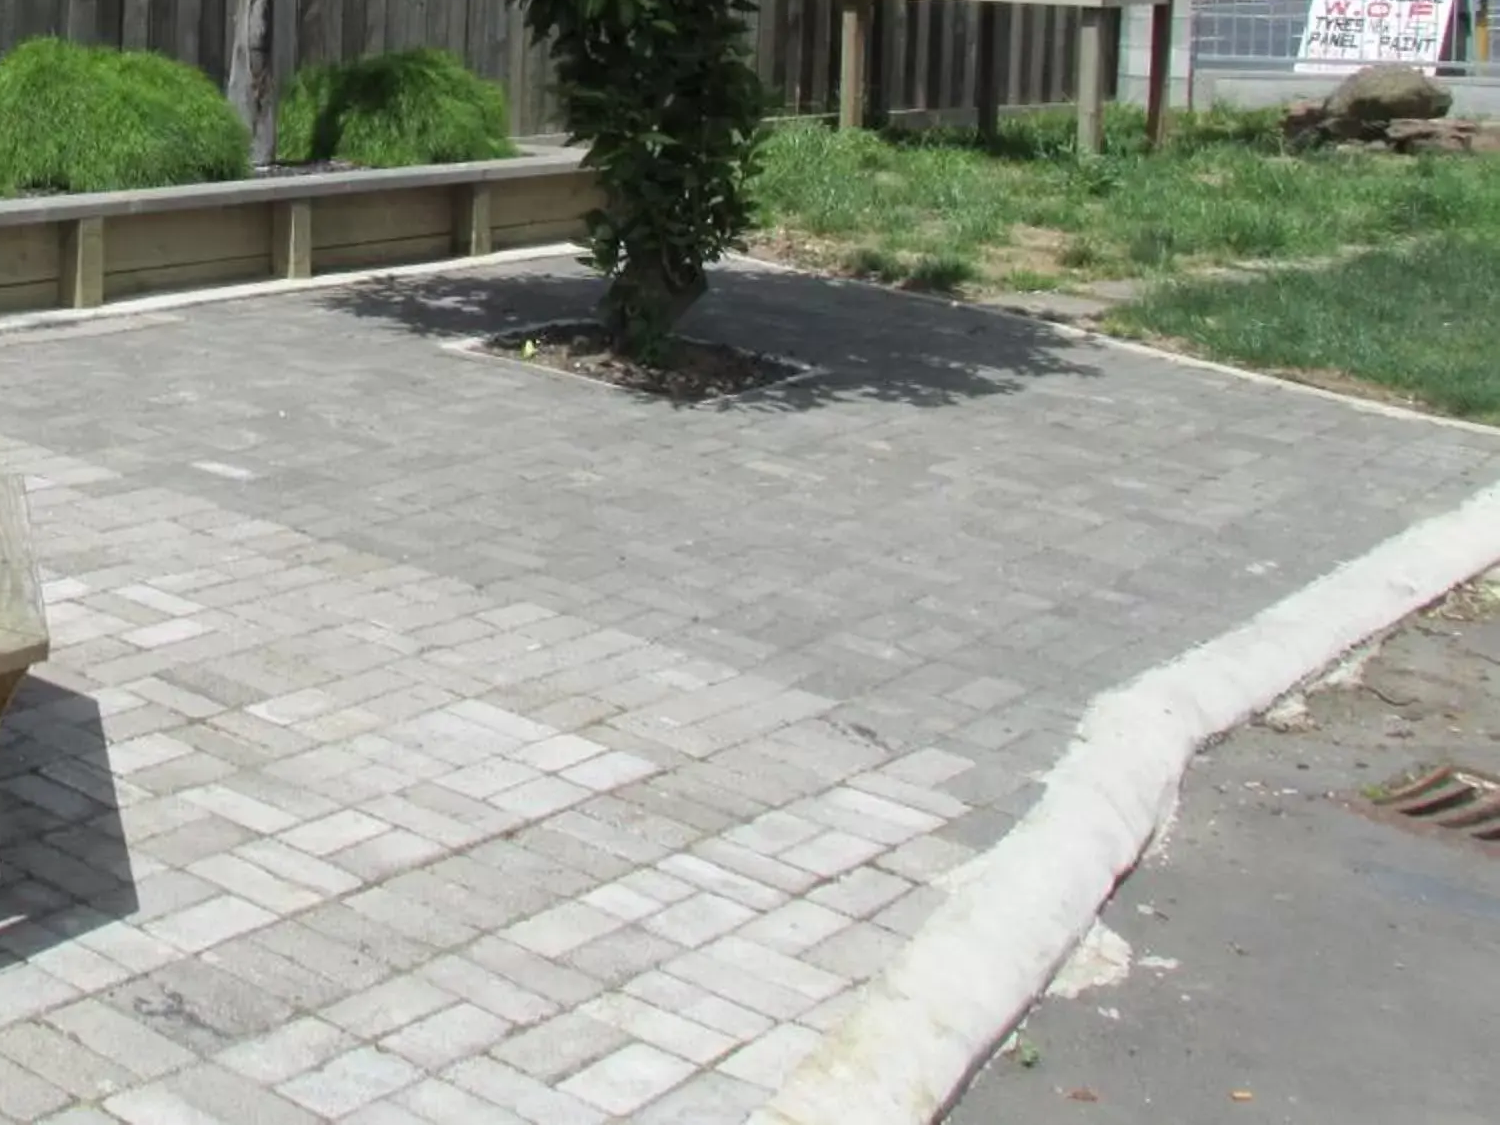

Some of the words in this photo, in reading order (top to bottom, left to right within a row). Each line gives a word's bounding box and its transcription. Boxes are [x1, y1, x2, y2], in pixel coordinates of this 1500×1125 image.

[1316, 16, 1365, 32] TYRES
[1307, 32, 1359, 49] PANEL
[1380, 36, 1438, 53] PAINT
